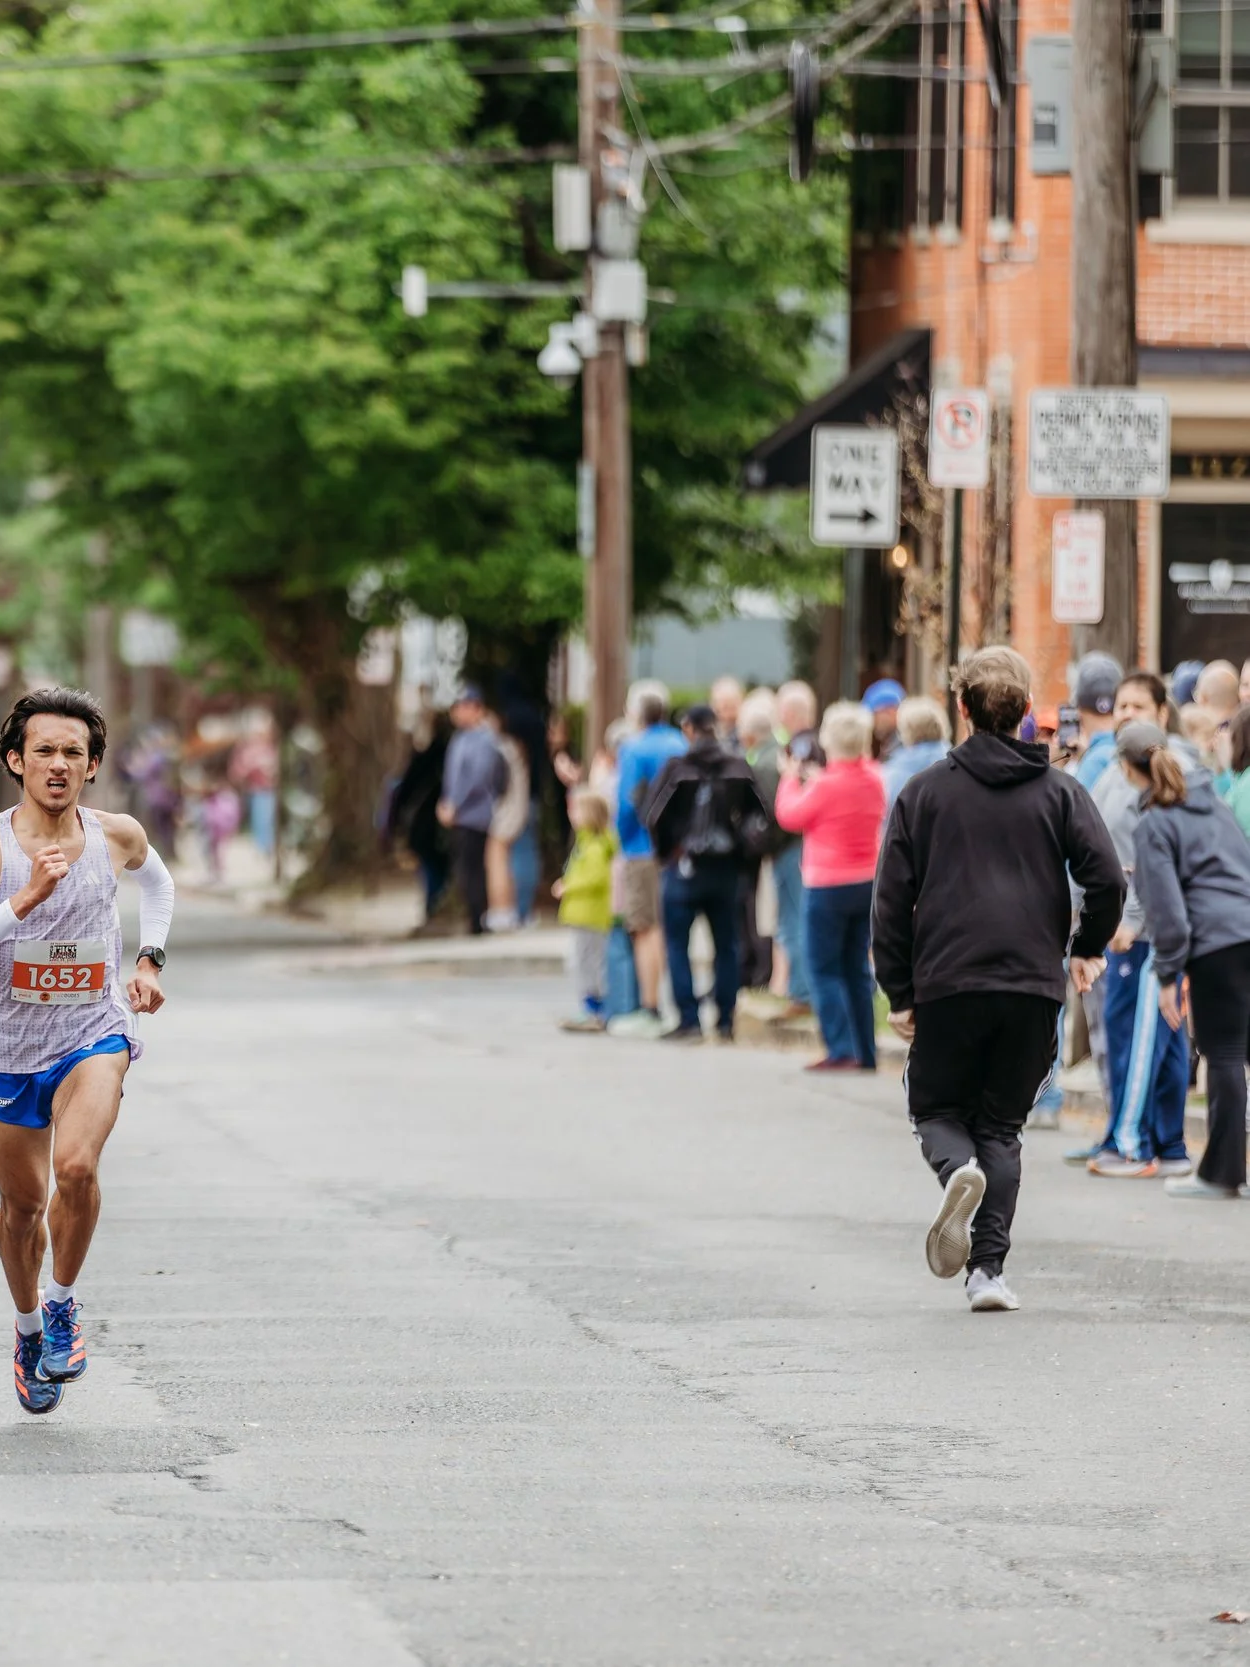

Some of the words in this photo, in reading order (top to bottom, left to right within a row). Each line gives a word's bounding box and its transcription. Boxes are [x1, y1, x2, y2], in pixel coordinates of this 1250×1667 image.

[830, 444, 881, 463] ONE
[830, 473, 885, 496] WAY
[28, 967, 92, 989] 1652
